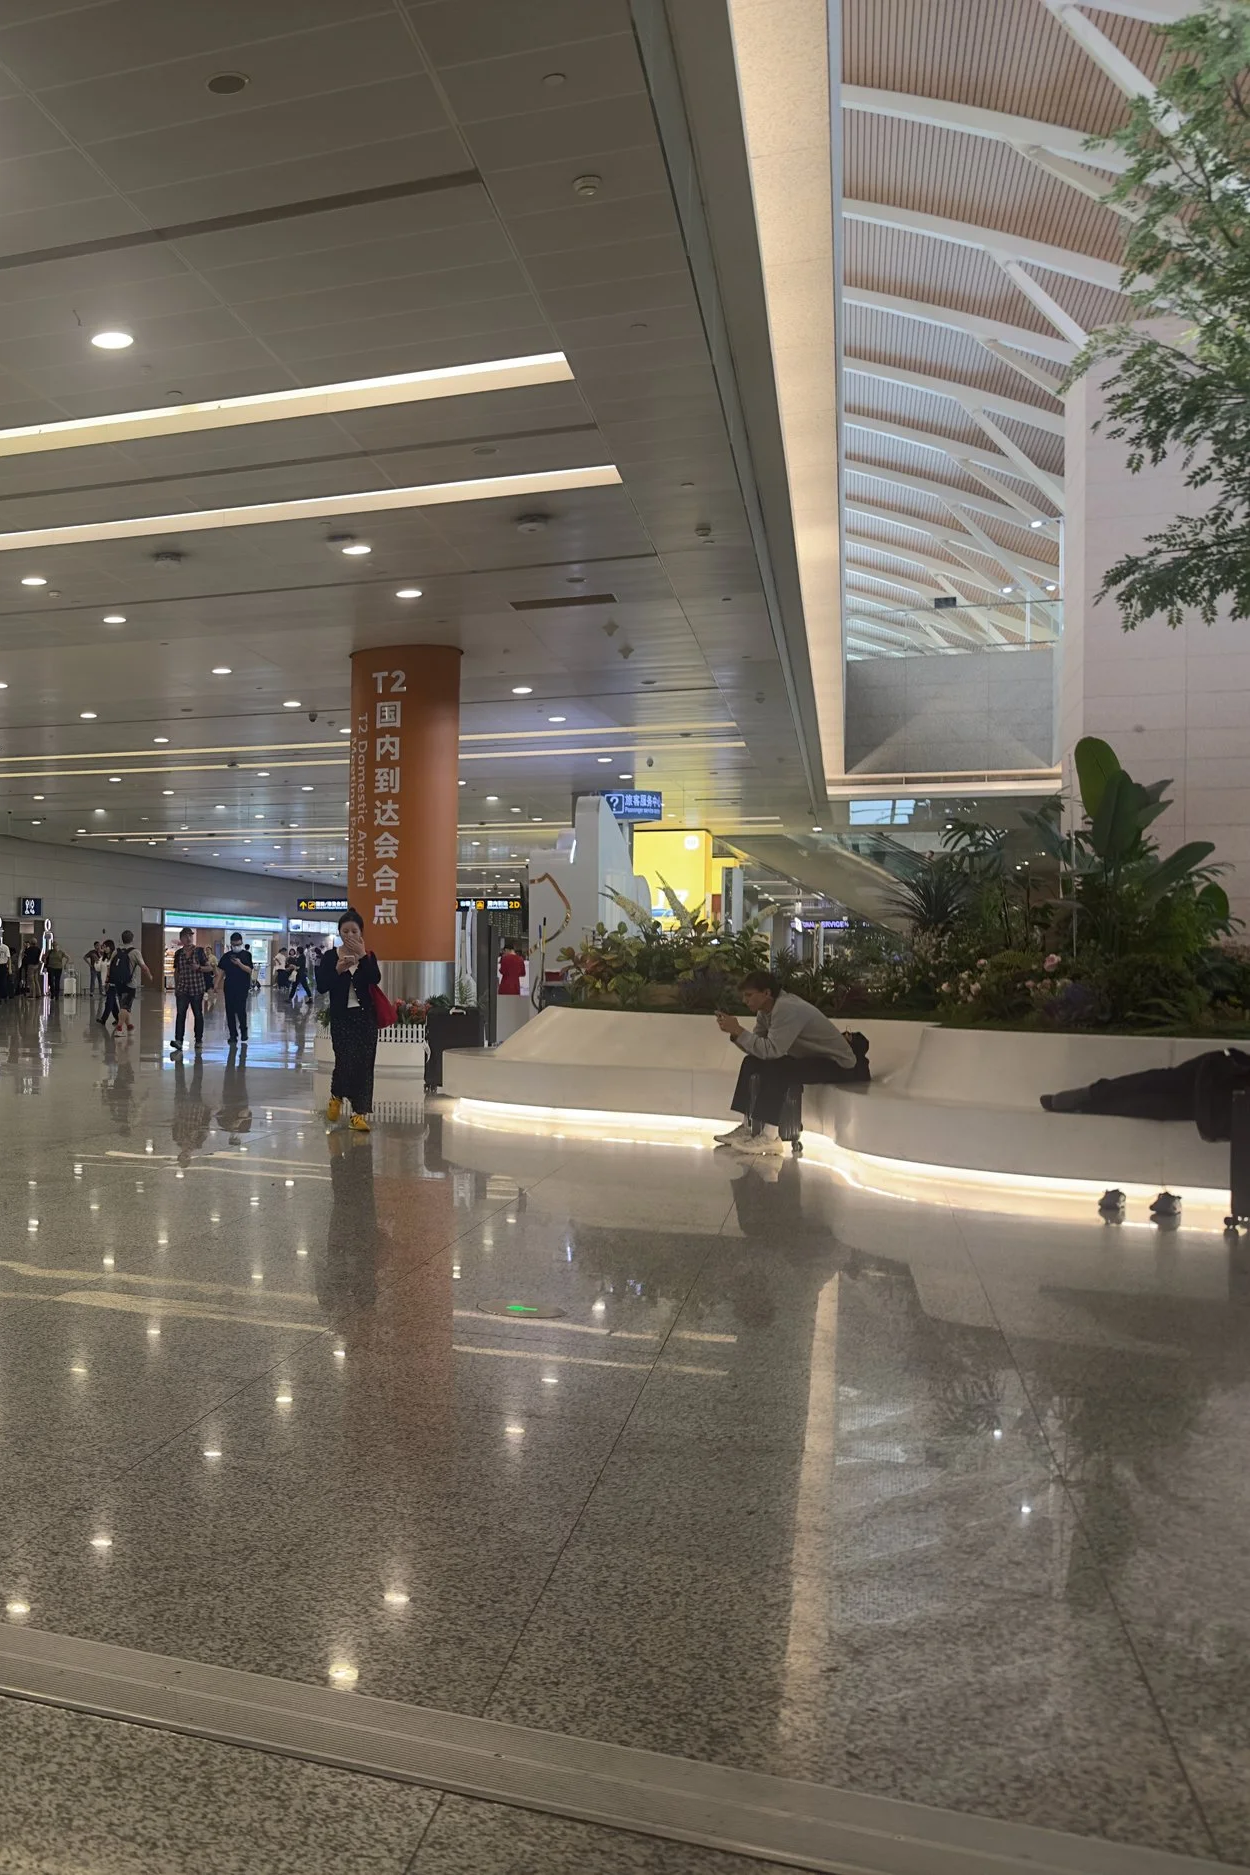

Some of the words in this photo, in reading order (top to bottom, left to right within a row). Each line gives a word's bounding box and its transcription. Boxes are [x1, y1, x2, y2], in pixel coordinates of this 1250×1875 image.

[372, 670, 407, 693] T2
[358, 712, 368, 734] T2
[357, 740, 368, 824] Domestic
[373, 701, 402, 925] 国内到达会合点
[356, 829, 368, 887] Arrival
[508, 901, 520, 909] 2D
